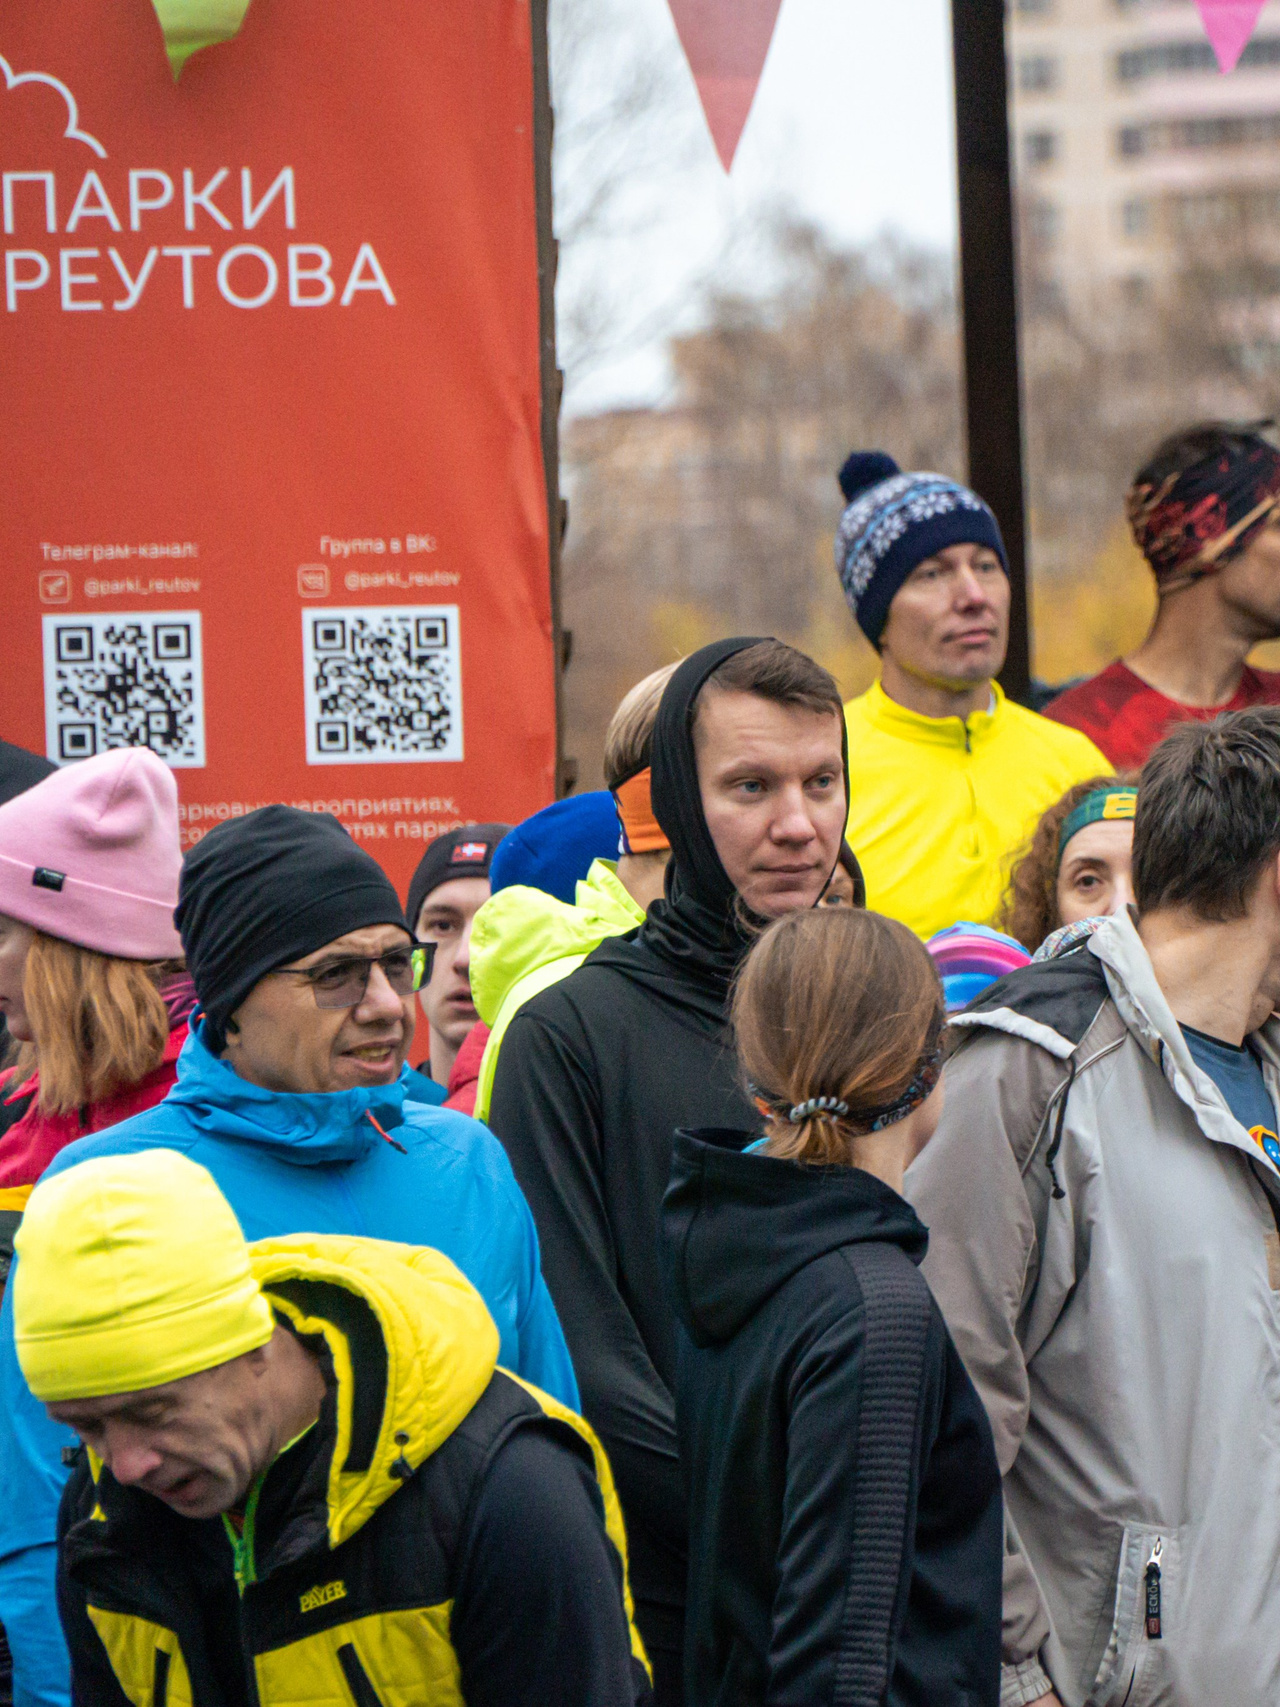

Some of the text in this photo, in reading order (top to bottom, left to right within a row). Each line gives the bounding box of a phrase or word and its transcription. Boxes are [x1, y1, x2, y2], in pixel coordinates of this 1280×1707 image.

[2, 166, 297, 234] ПАРКИ
[4, 243, 398, 312] РЕУТОВА
[320, 535, 386, 558] Группа
[389, 537, 402, 553] в
[84, 576, 200, 598] @parki_reutov
[300, 1580, 347, 1613] PAYER
